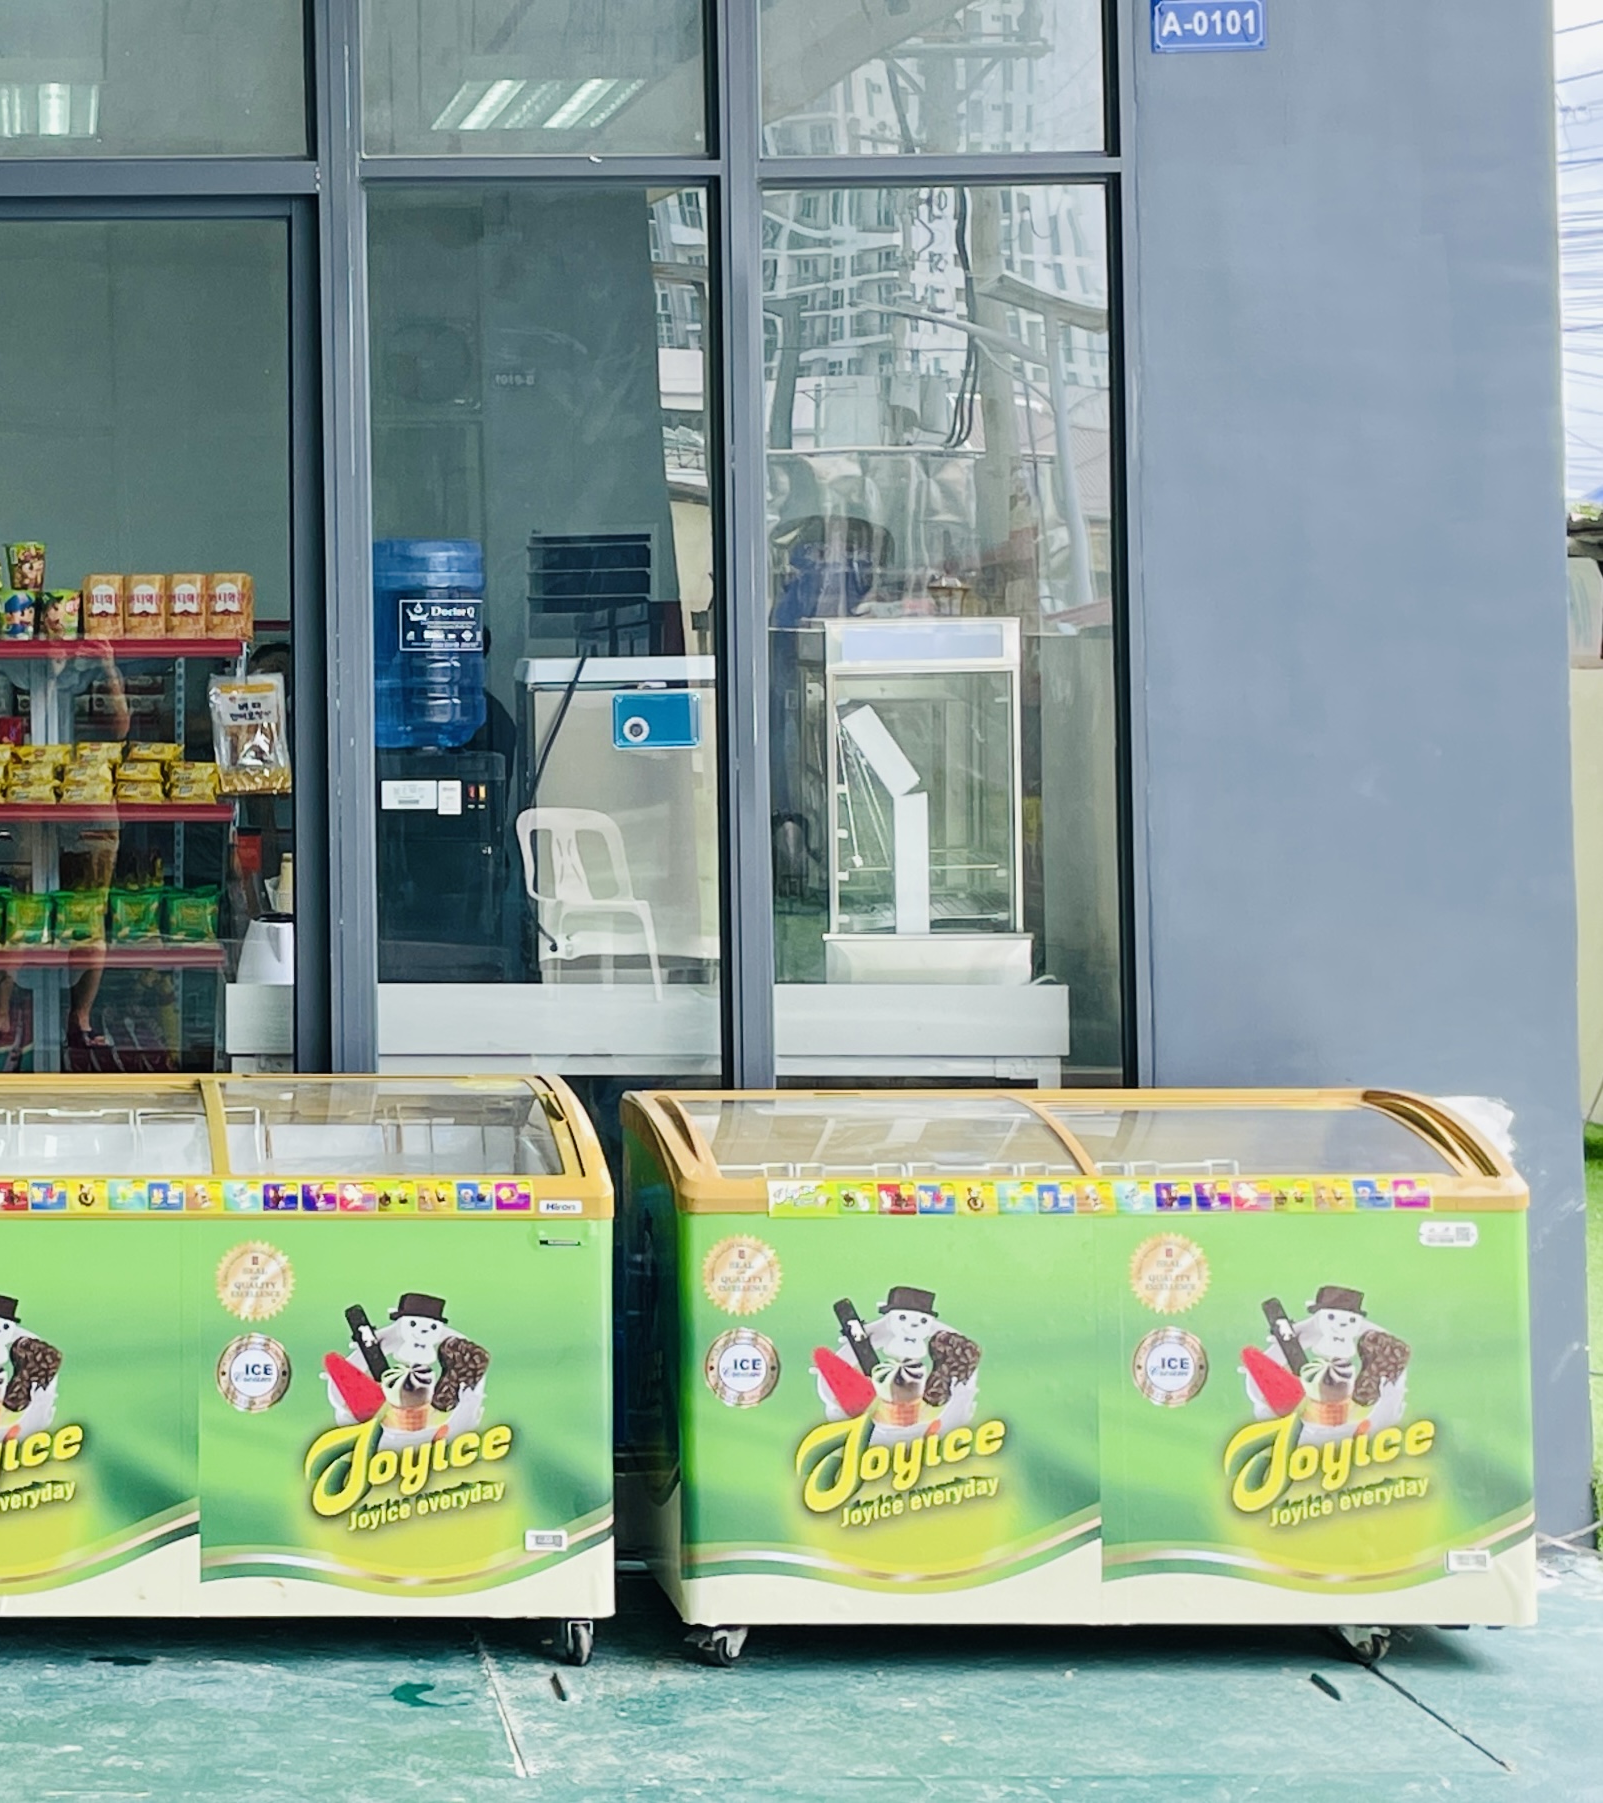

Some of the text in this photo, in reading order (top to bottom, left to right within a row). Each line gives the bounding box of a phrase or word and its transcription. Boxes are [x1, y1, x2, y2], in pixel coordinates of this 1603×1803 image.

[1161, 9, 1256, 37] A-0101
[234, 1282, 277, 1290] QUALITY
[245, 1364, 274, 1376] ICE
[733, 1358, 762, 1370] ICE
[1161, 1357, 1189, 1370] ICE
[304, 1417, 513, 1516] Joyice
[795, 1413, 1006, 1512] Joyice
[1224, 1412, 1435, 1512] Joyice
[348, 1481, 505, 1531] Joyice everyday
[841, 1476, 999, 1528] Joyice everyday
[1269, 1476, 1429, 1528] Joyice everyday
